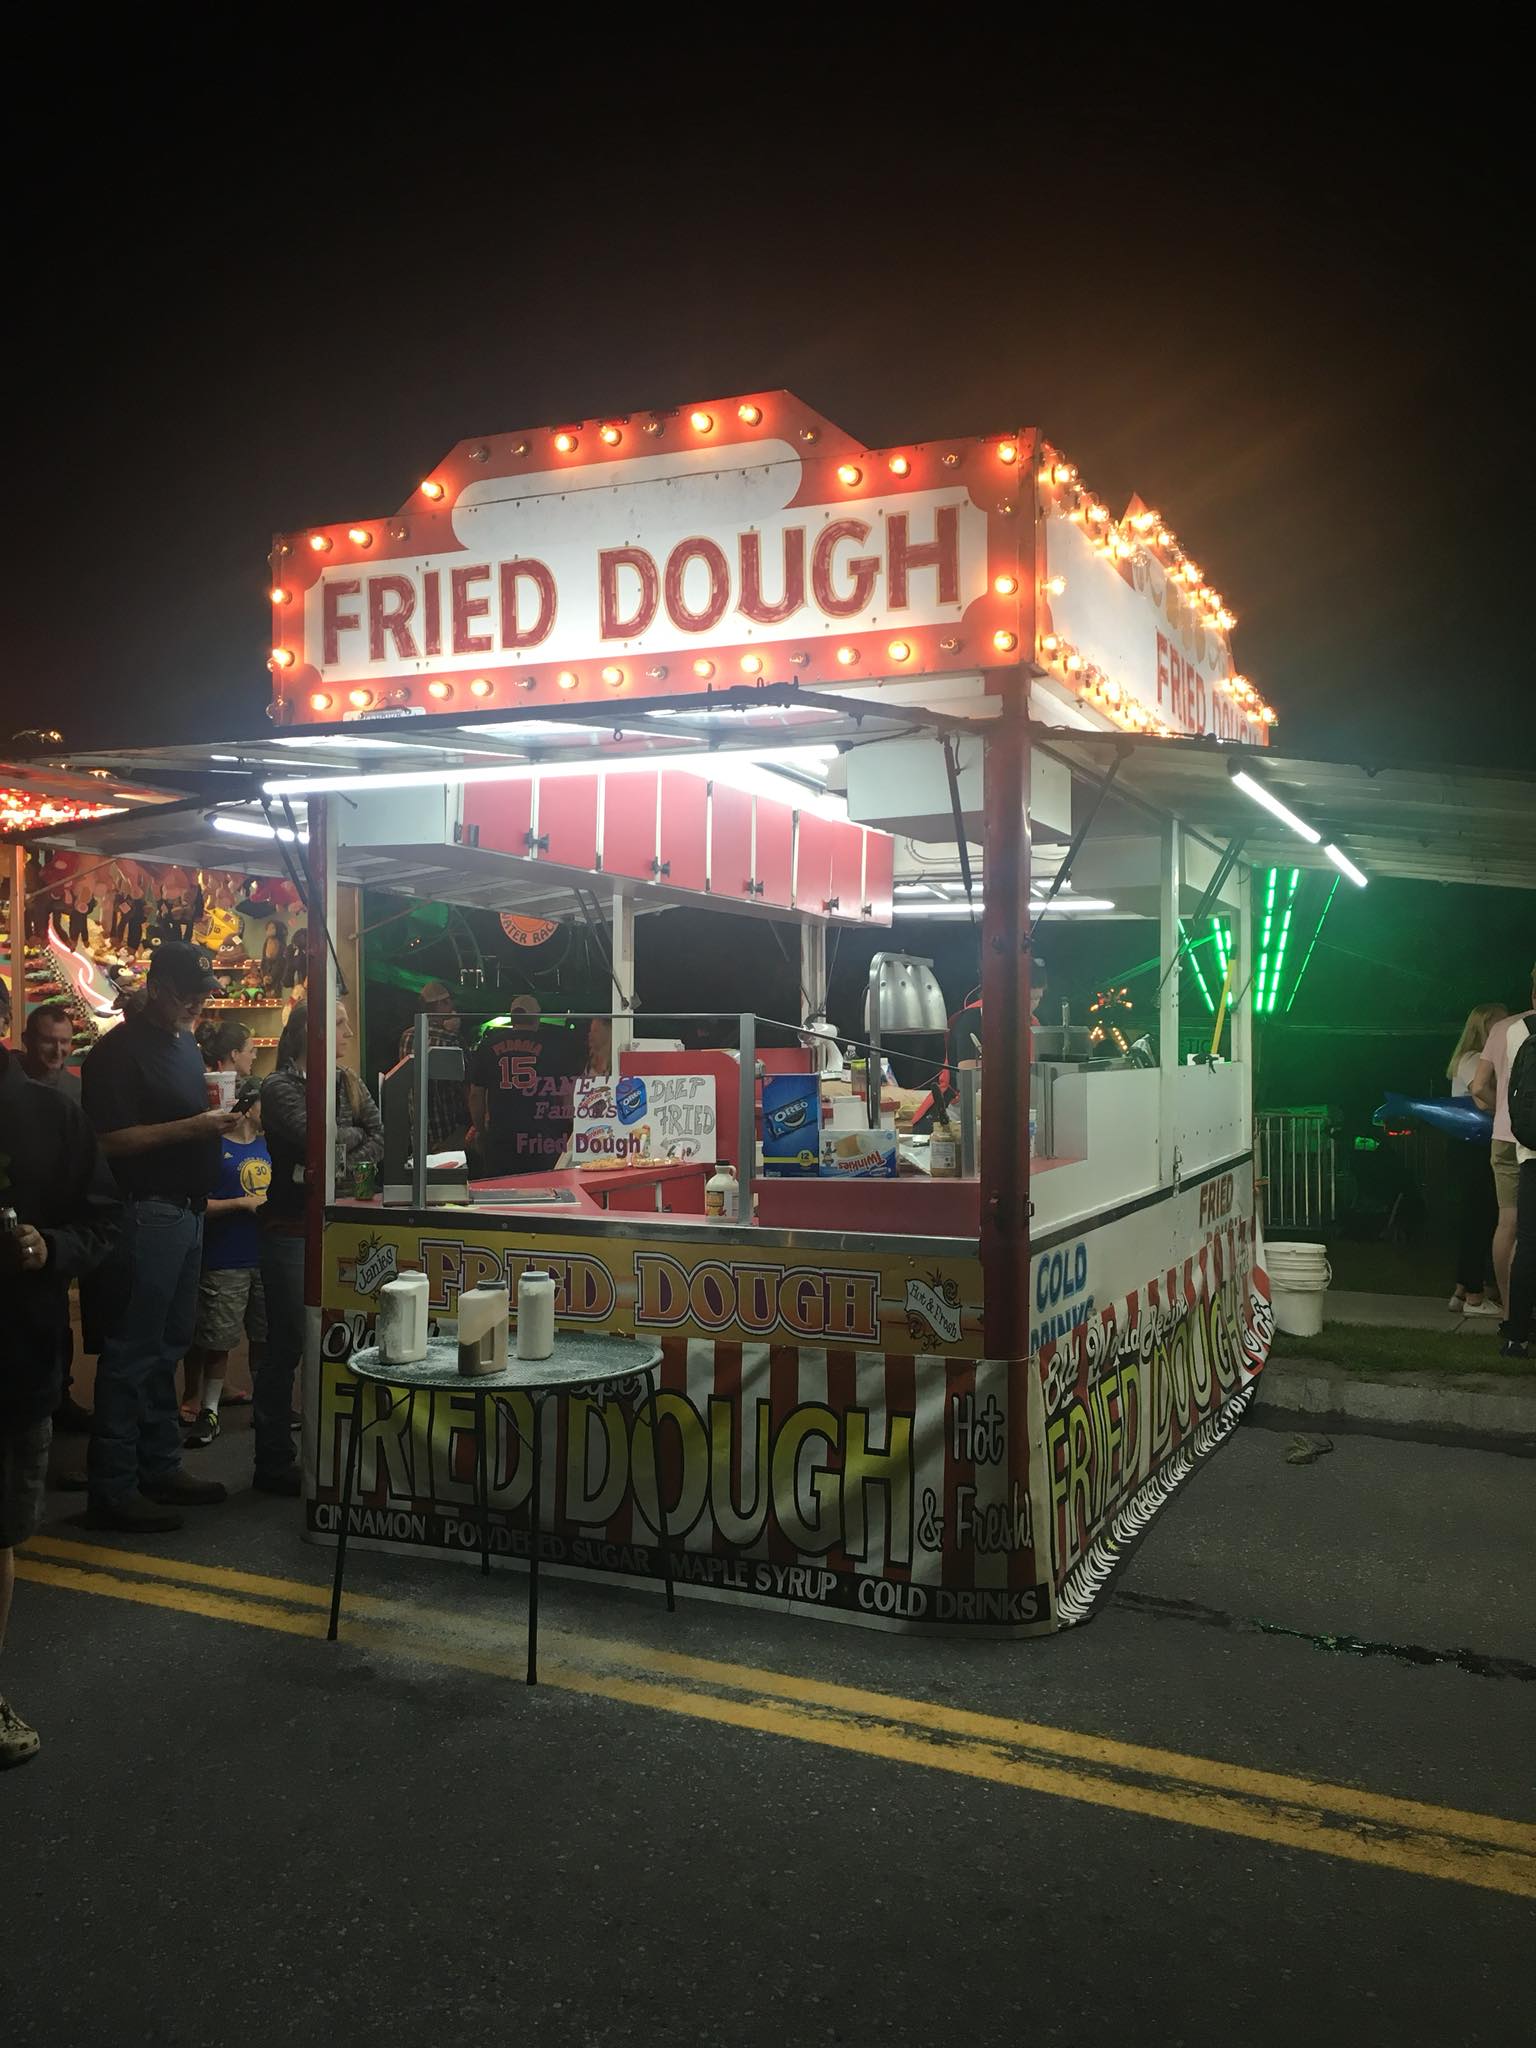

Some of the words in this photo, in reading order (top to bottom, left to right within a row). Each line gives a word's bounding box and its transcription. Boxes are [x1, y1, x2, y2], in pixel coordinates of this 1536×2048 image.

[321, 558, 559, 667] FRIED
[597, 502, 962, 642] DOUGH
[1155, 629, 1206, 736] FRIED
[531, 919, 560, 944] RAC
[498, 1056, 537, 1089] 15
[533, 1100, 618, 1120] Famous
[623, 1090, 642, 1106] OREO
[774, 1101, 809, 1122] OREO
[653, 1103, 715, 1137] FRIED
[515, 1131, 567, 1154] Fried
[575, 1133, 640, 1158] Dough
[800, 1151, 810, 1161] 12
[838, 1151, 888, 1172] Twinkies
[254, 1166, 268, 1176] 30
[1199, 1173, 1234, 1229] FRIED
[358, 1247, 394, 1290] Janies
[1035, 1243, 1088, 1313] COLD
[634, 1251, 882, 1343] DOUGH
[933, 1303, 958, 1339] Fresh
[951, 1393, 1004, 1465] Hot
[317, 1363, 540, 1512] FRIED
[566, 1388, 915, 1568] DOUGH
[1045, 1362, 1141, 1570] FRIED
[1111, 1475, 1168, 1544] POWDERED
[1193, 1411, 1227, 1457] MAPLE
[918, 1488, 944, 1551] &
[571, 1540, 652, 1575] SUGAR
[670, 1554, 748, 1588] MAPLE
[754, 1565, 838, 1600] SYRUP
[858, 1579, 926, 1617] COLD
[935, 1589, 1039, 1620] DRINKS
